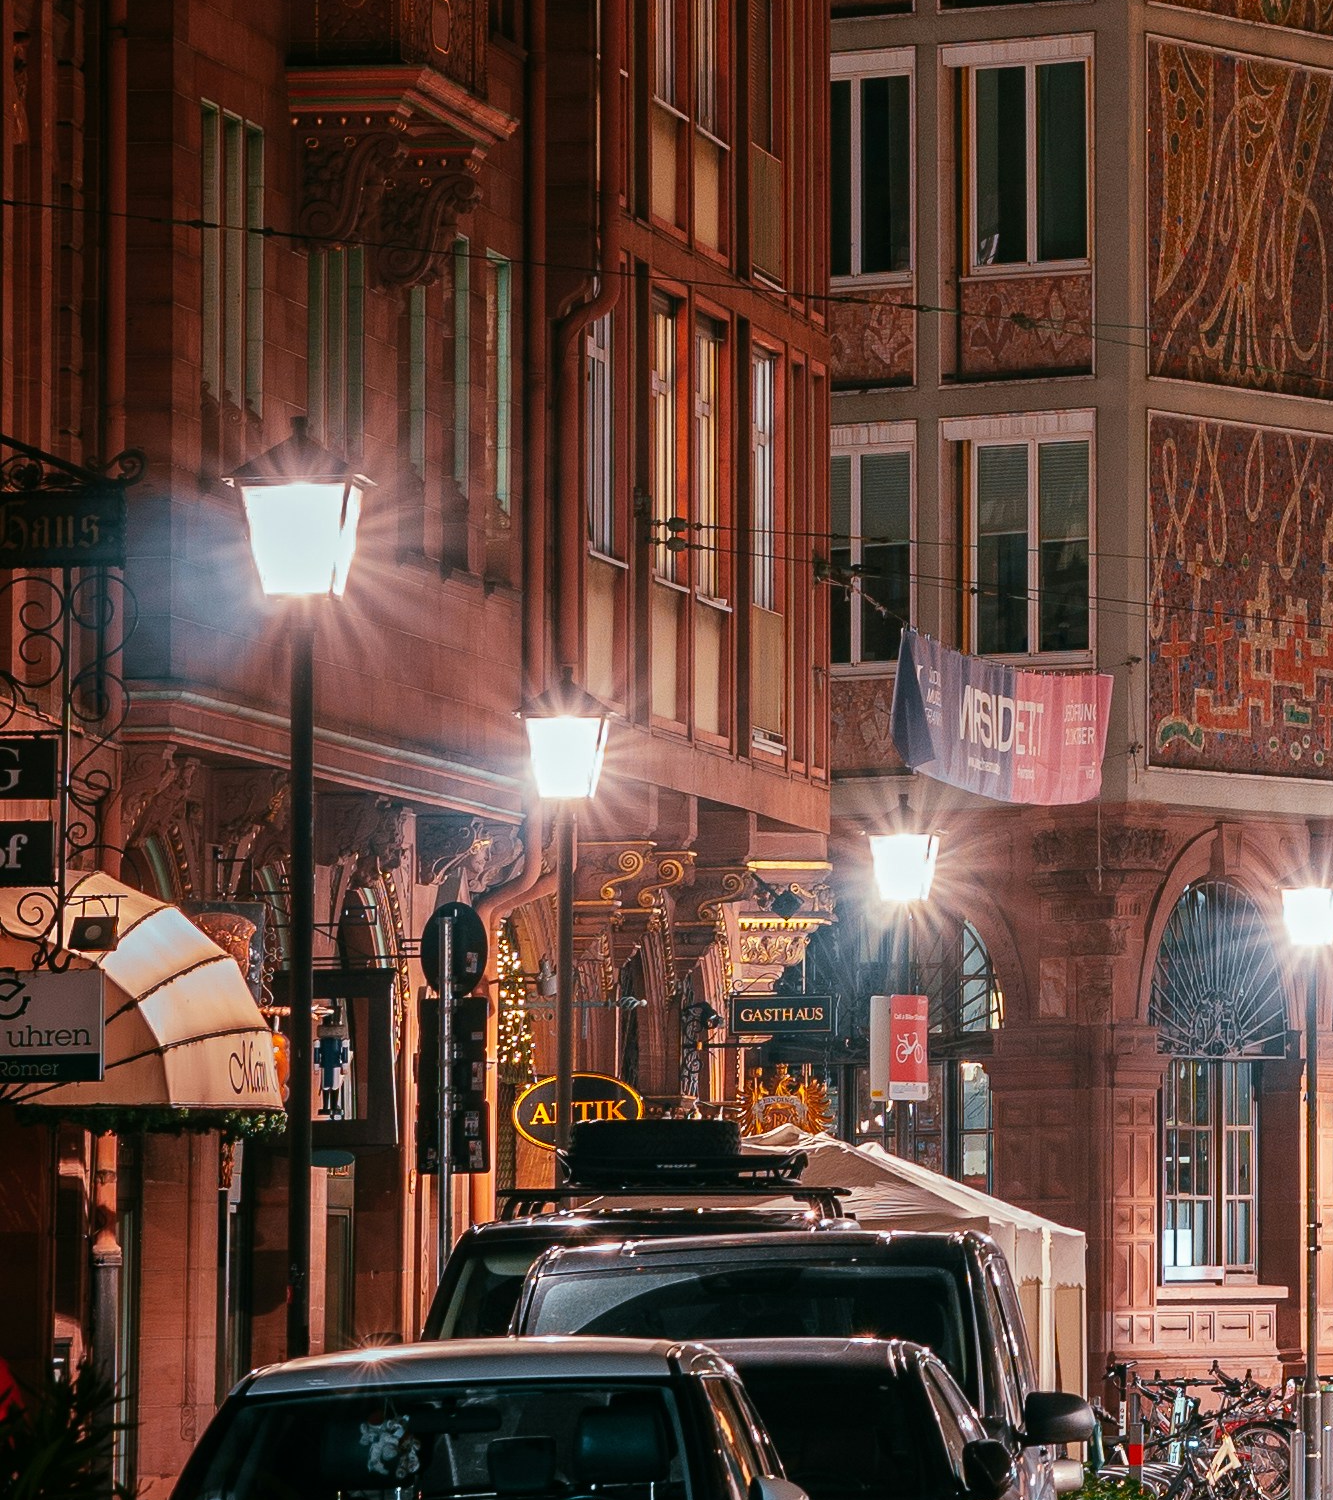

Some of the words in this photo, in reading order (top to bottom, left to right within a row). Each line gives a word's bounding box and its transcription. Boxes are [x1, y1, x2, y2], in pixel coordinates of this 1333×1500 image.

[740, 1007, 824, 1022] GASTHAUS
[6, 1025, 91, 1047] uhren
[0, 1061, 59, 1077] Römer
[229, 1040, 269, 1095] Main
